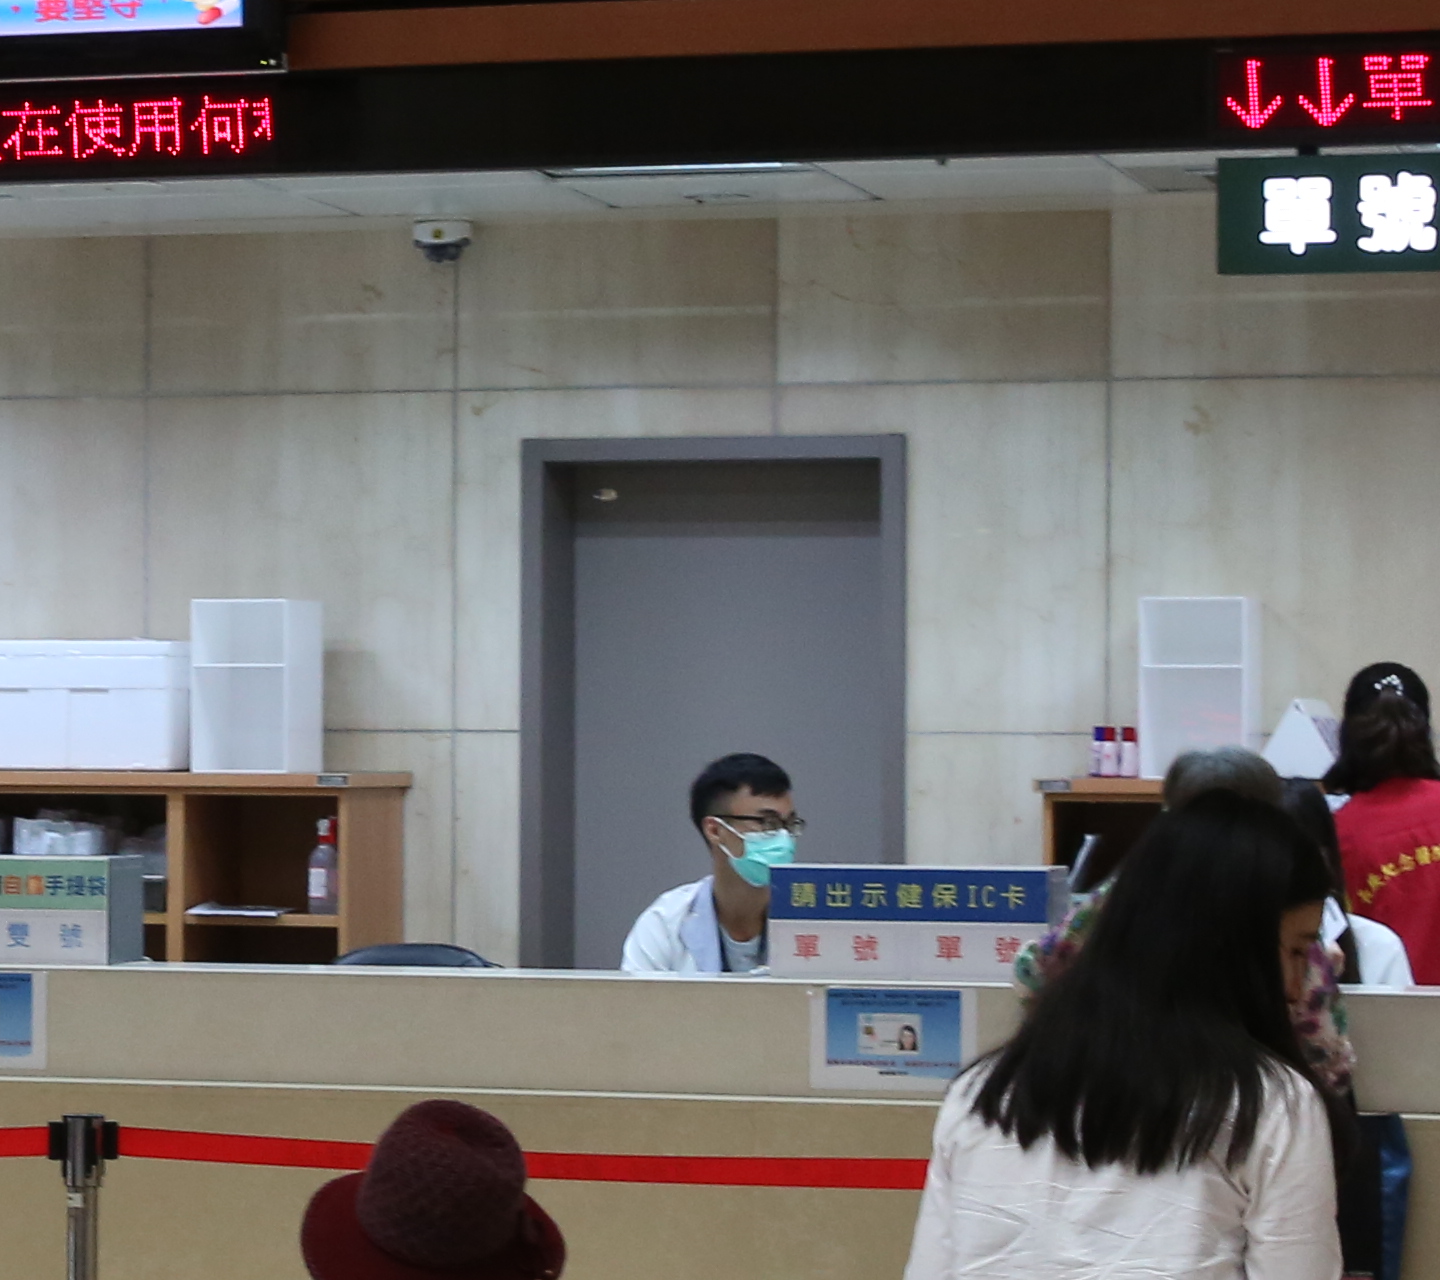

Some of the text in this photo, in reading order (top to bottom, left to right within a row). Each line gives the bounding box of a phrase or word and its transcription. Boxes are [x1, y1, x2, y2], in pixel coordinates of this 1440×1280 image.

[1258, 169, 1439, 255] 單號
[789, 881, 1027, 911] 請出示健保IC卡
[6, 922, 84, 949] 雙號
[792, 933, 880, 962] 單號
